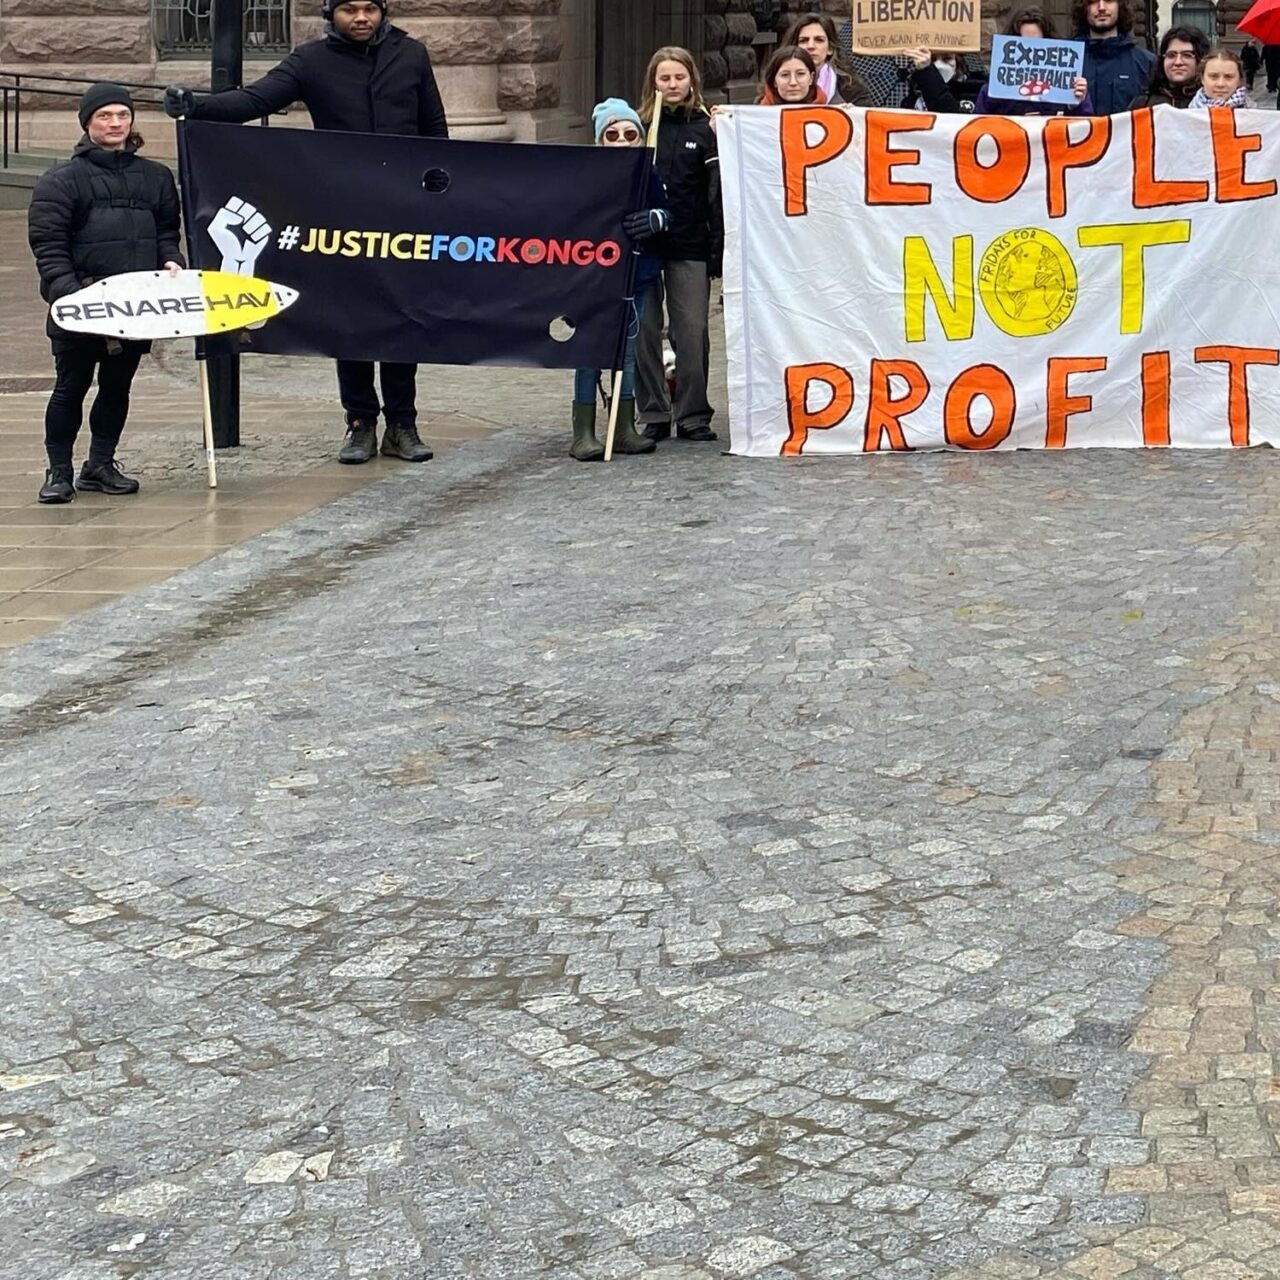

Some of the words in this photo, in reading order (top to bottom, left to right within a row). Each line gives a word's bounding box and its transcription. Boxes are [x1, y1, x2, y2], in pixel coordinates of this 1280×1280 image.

[857, 35, 886, 48] NEVER
[888, 33, 912, 45] AGAIN
[915, 33, 929, 44] FOR
[1001, 40, 1079, 68] EXPECT
[780, 106, 1278, 218] PEOPLE
[277, 224, 621, 266] #JUSTICEFORKONGO
[980, 237, 1011, 282] FRIDAYS
[1013, 230, 1036, 240] FOR
[903, 219, 1191, 343] NOT
[1045, 287, 1076, 330] FUTURE
[780, 345, 1280, 456] PROFIT
